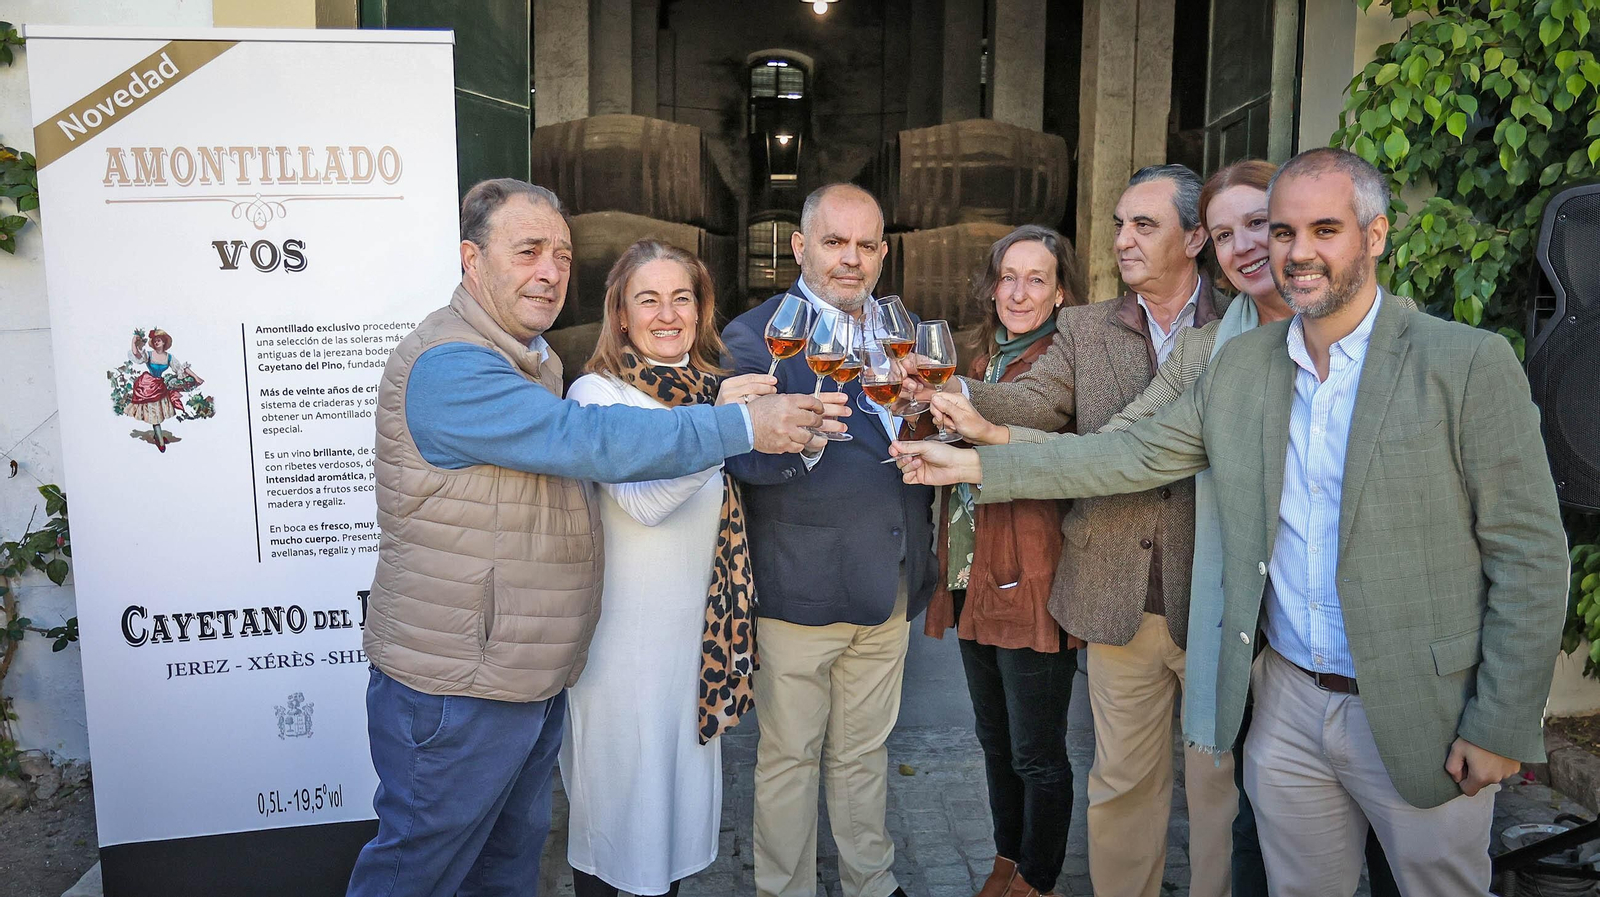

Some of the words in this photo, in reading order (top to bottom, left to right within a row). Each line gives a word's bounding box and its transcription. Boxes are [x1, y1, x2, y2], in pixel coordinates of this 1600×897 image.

[55, 52, 181, 142] Novedad
[102, 145, 404, 187] AMONTILLADO
[211, 238, 308, 274] VOS
[256, 324, 314, 334] Amontillado
[317, 323, 360, 332] exclusivo
[363, 321, 415, 332] procedente
[277, 336, 319, 345] selección
[321, 336, 333, 344] de
[335, 335, 348, 344] las
[351, 335, 383, 343] soleras
[257, 351, 297, 361] antiguas
[300, 350, 311, 358] de
[314, 349, 321, 357] la
[323, 348, 362, 359] jerezana
[258, 363, 302, 373] Cayetano
[305, 362, 319, 370] del
[322, 362, 345, 370] Pino,
[347, 360, 385, 369] fundada
[260, 388, 280, 396] Más
[296, 387, 325, 395] veinte
[328, 386, 349, 394] años
[352, 385, 363, 393] de
[366, 384, 378, 392] cri
[261, 401, 296, 409] sistema
[299, 400, 310, 408] de
[313, 399, 354, 407] criaderas
[357, 399, 362, 407] y
[262, 414, 299, 422] obtener
[315, 410, 371, 420] Amontillado
[263, 425, 302, 435] especial.
[265, 451, 274, 459] Es
[291, 450, 311, 458] vino
[313, 448, 355, 457] brillante,
[358, 447, 369, 455] de
[285, 462, 316, 470] ribetes
[319, 461, 363, 469] verdosos,
[266, 475, 315, 484] intensidad
[317, 473, 367, 482] aromática,
[267, 487, 313, 496] recuerdos
[323, 485, 351, 494] frutos
[353, 484, 376, 493] seco
[268, 500, 303, 508] madera
[313, 498, 345, 507] regaliz.
[270, 525, 281, 533] En
[284, 524, 306, 532] boca
[321, 522, 352, 531] fresco,
[355, 521, 374, 529] muy
[271, 535, 302, 545] mucho
[305, 535, 339, 545] cuerpo.
[342, 532, 381, 542] Presenta
[271, 548, 316, 558] avellanas,
[319, 546, 348, 557] regaliz
[351, 546, 356, 554] y
[121, 604, 307, 648] CAYETANO
[313, 609, 351, 630] DEL
[166, 660, 230, 680] JEREZ
[248, 651, 315, 671] XÉRÈS
